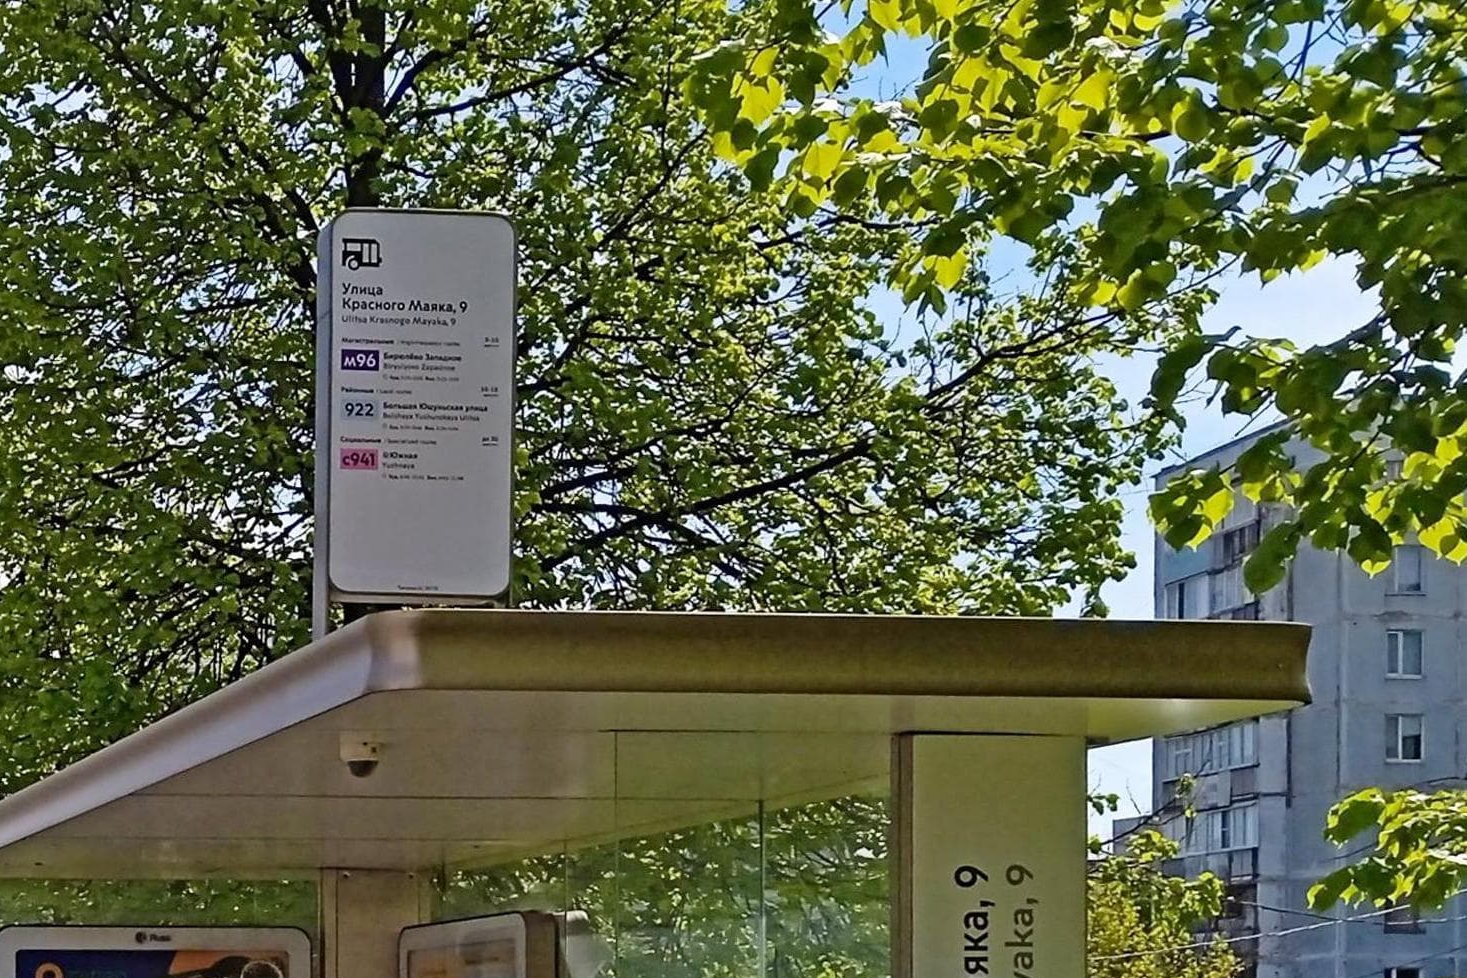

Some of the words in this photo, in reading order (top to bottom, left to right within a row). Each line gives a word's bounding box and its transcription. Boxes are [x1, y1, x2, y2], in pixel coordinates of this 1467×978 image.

[342, 283, 383, 297] Улица
[342, 298, 405, 312] Красного
[408, 300, 457, 314] Маяка,
[459, 301, 468, 313] 9
[342, 316, 367, 324] Ulitsa
[370, 316, 411, 327] Krasnogo
[345, 402, 374, 417] 922
[342, 451, 376, 467] с941
[954, 865, 989, 888] 9
[1006, 865, 1034, 885] 9
